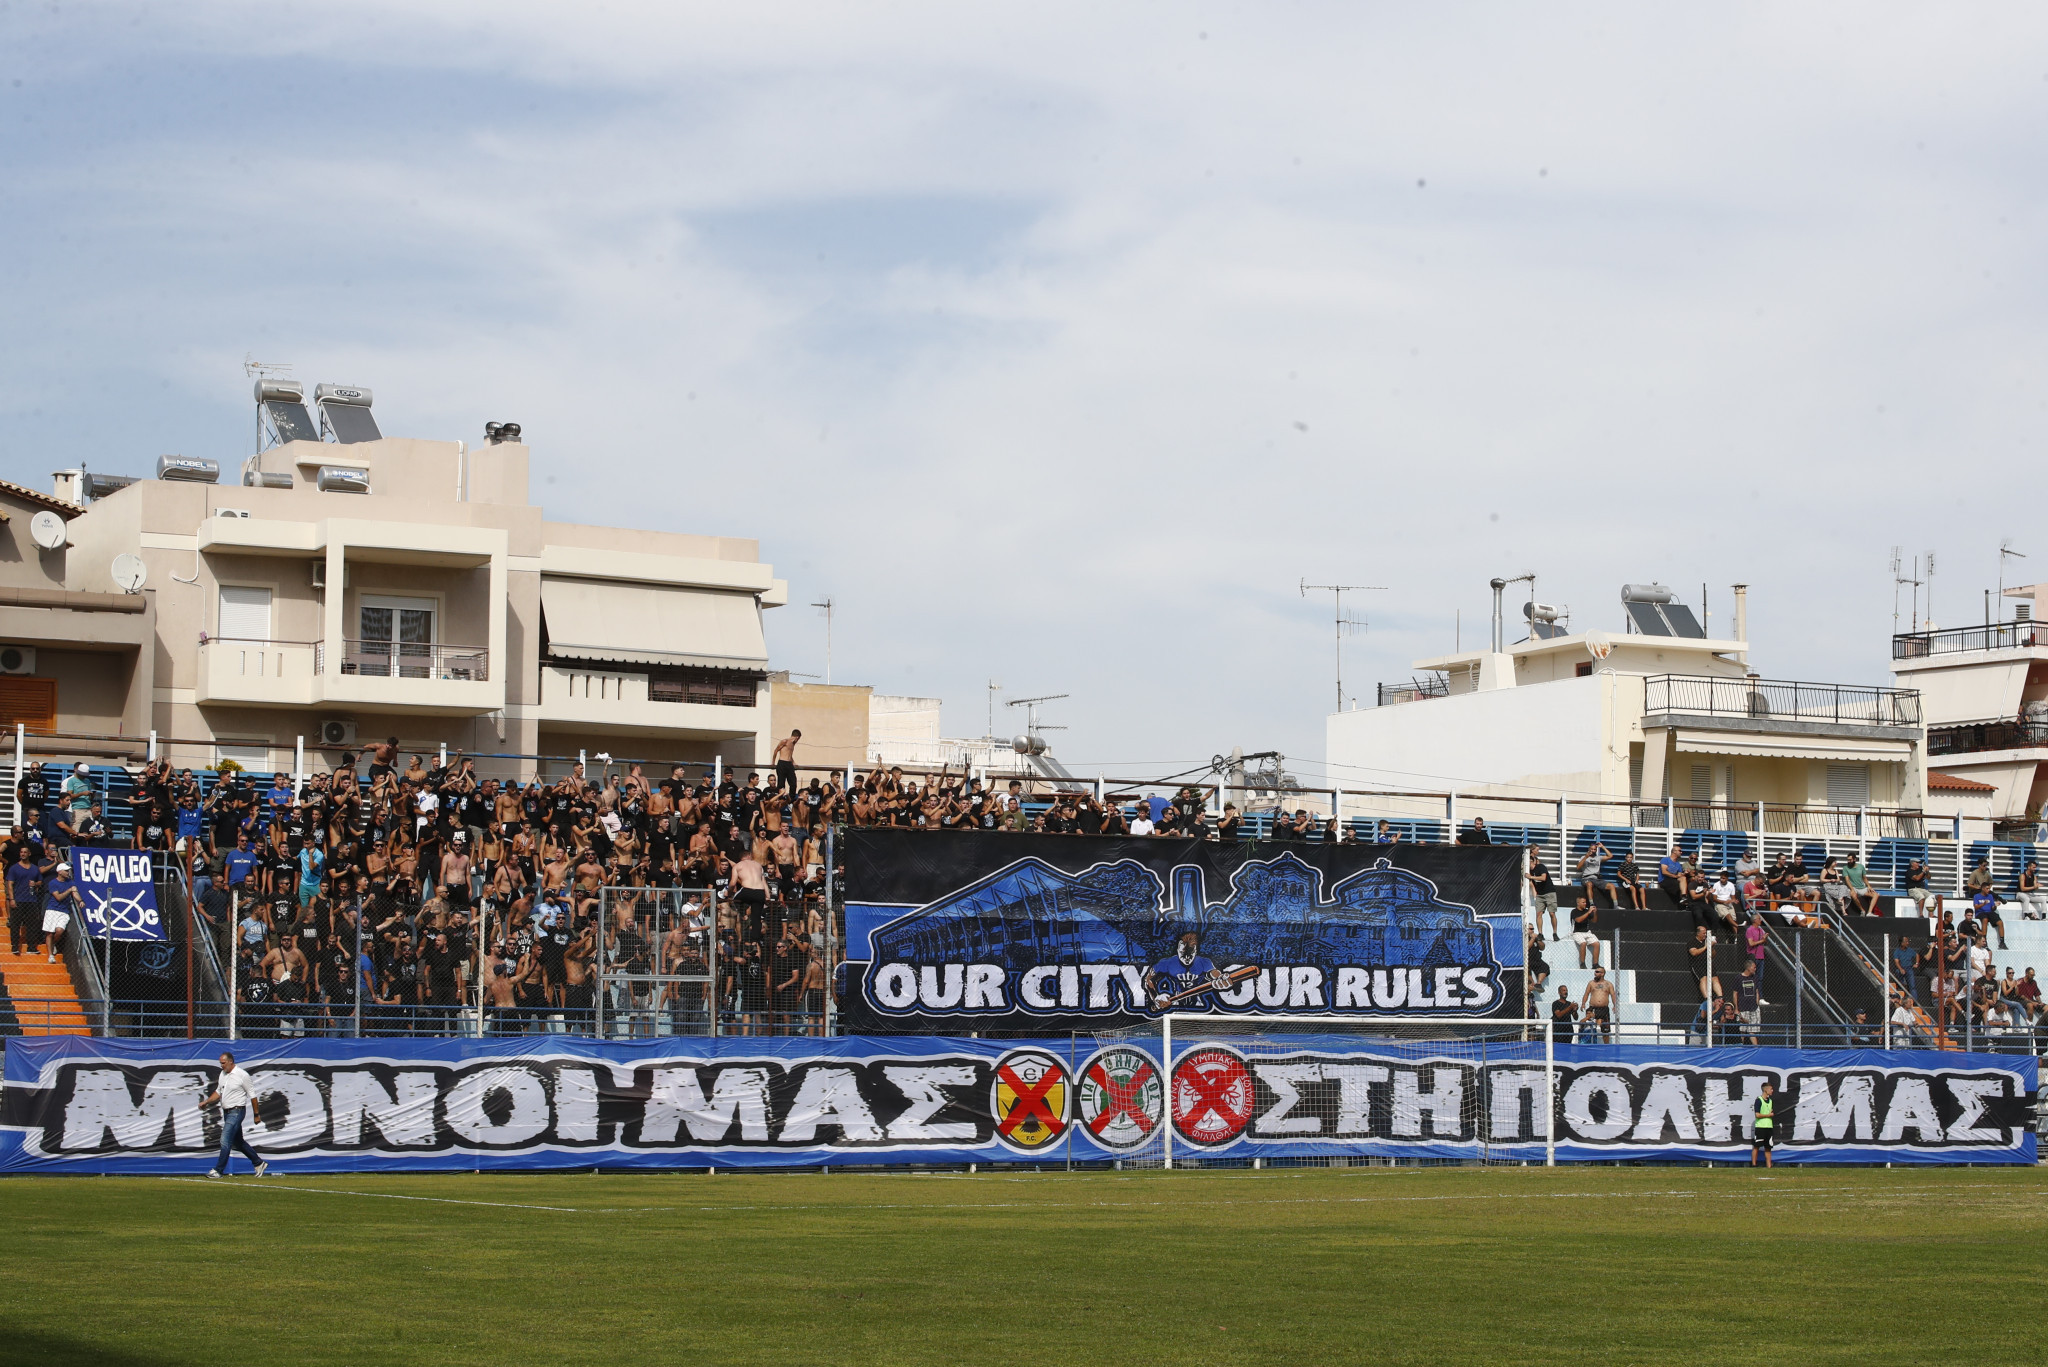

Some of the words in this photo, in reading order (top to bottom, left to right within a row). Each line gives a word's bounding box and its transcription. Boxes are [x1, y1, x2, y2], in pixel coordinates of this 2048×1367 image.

[176, 459, 206, 468] NOBEL
[337, 470, 362, 478] NOBEL
[80, 853, 152, 883] EGALEO
[874, 963, 1006, 1008] OUR
[1021, 964, 1150, 1008] CITY
[1219, 964, 1325, 1007] OUR
[1336, 966, 1493, 1008] RULES
[60, 1065, 599, 1149] ΜΟΝΟΙ
[638, 1065, 978, 1143] ΜΑΣ
[1253, 1063, 1464, 1137] ΣΤΗ
[1489, 1069, 1769, 1141] ΠΟΛΗ
[1792, 1074, 2004, 1142] ΜΑΣ
